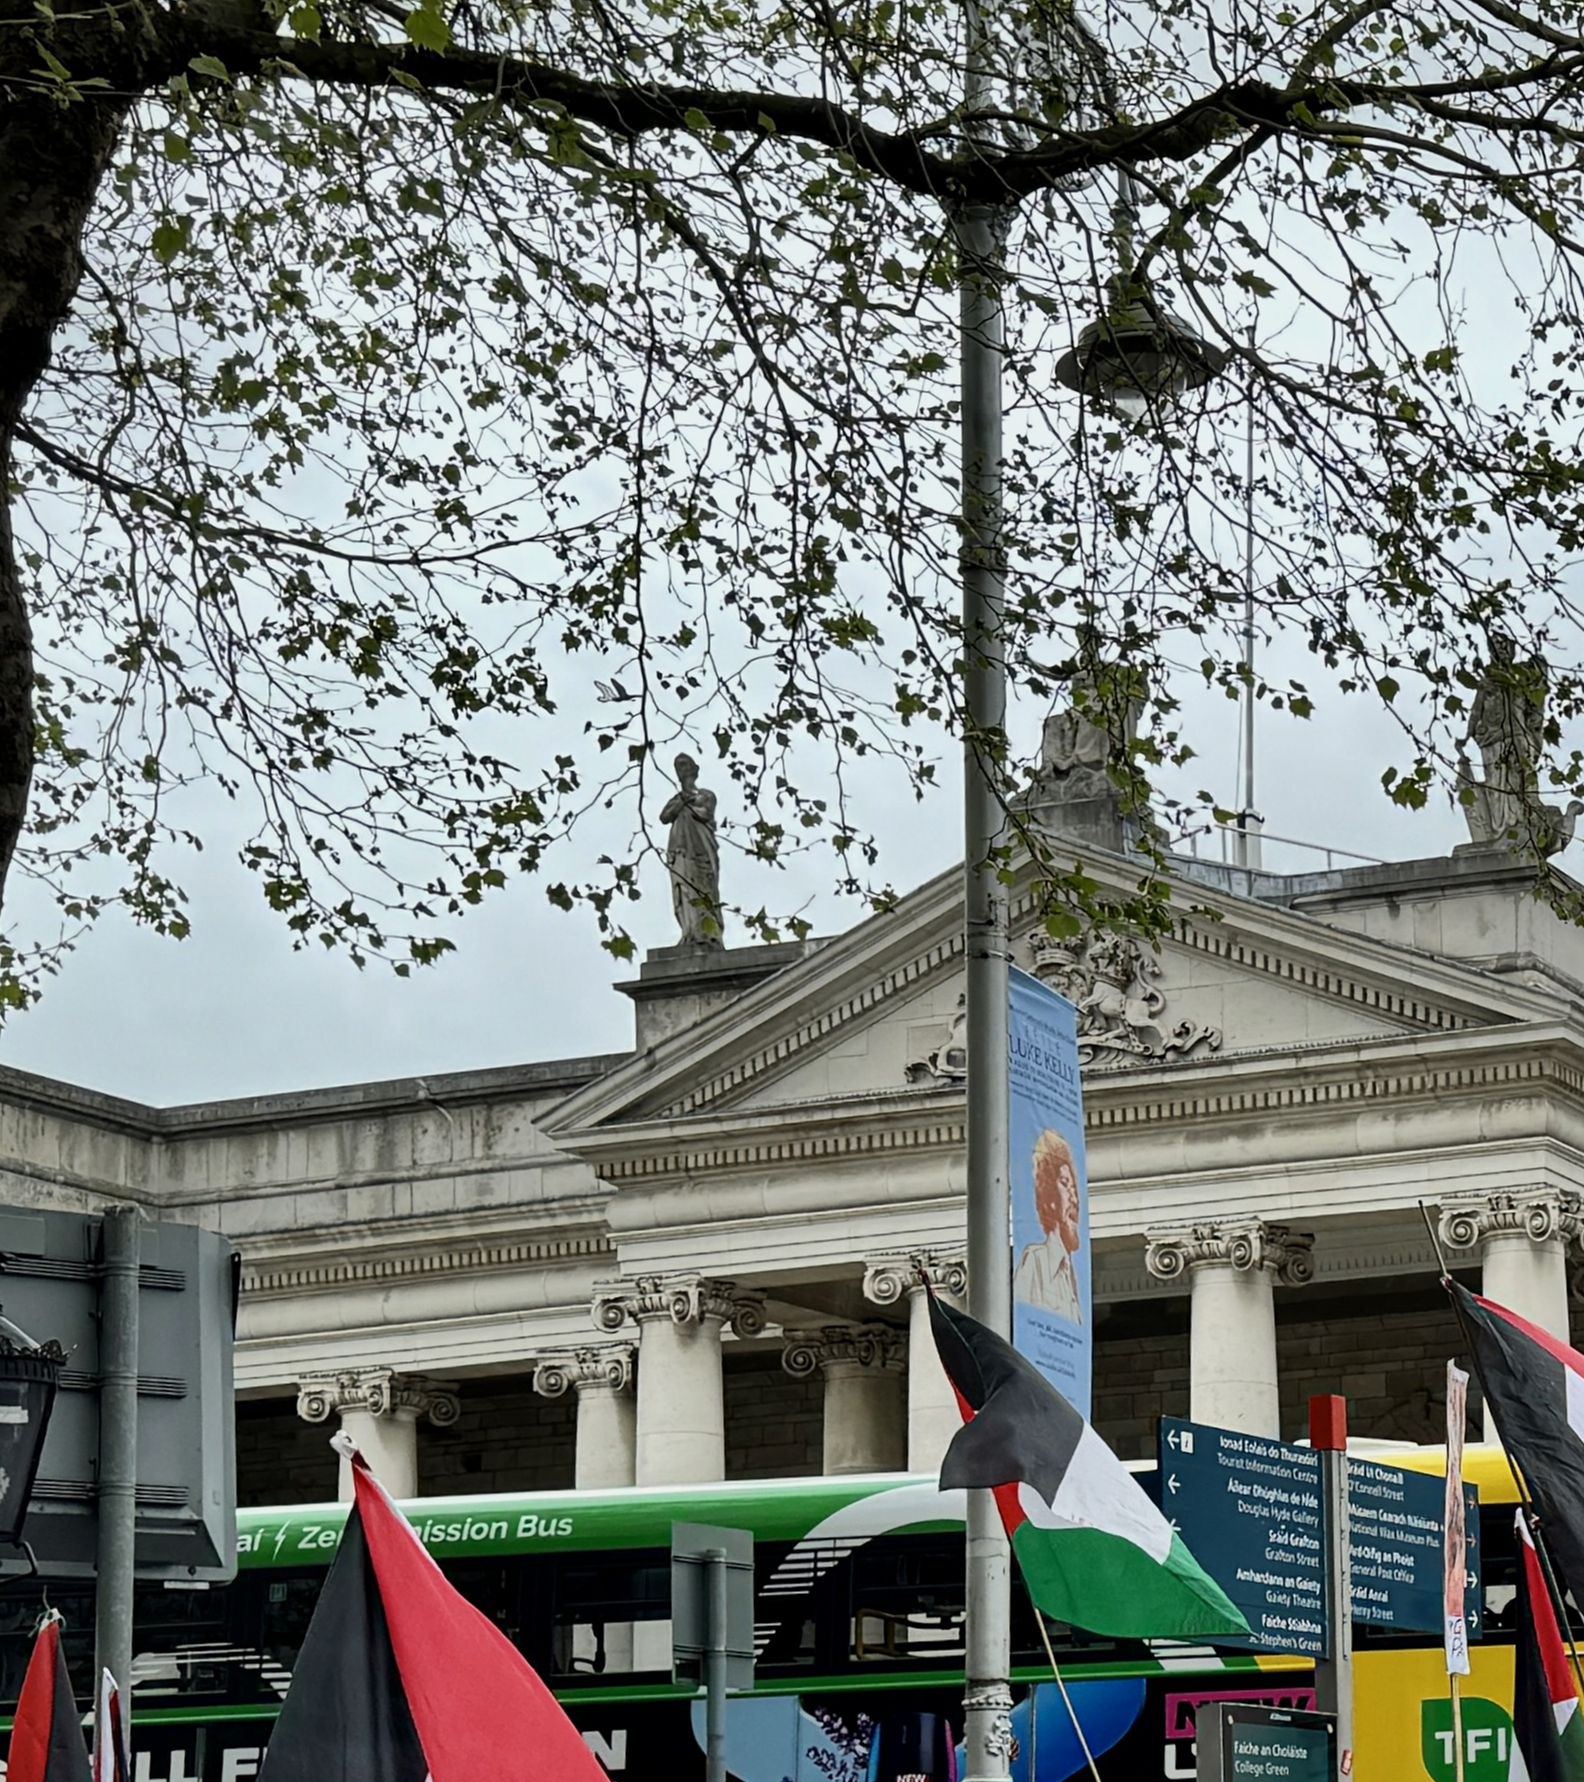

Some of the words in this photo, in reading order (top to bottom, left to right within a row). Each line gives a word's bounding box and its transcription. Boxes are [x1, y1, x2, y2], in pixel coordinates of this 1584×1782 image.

[1043, 1049, 1075, 1086] KELLY
[516, 1514, 574, 1539] Bus
[1233, 1740, 1259, 1757] Faiche
[1259, 1746, 1271, 1758] an
[1434, 1727, 1508, 1765] TFI
[1234, 1760, 1265, 1778] College
[1265, 1761, 1290, 1777] Green
